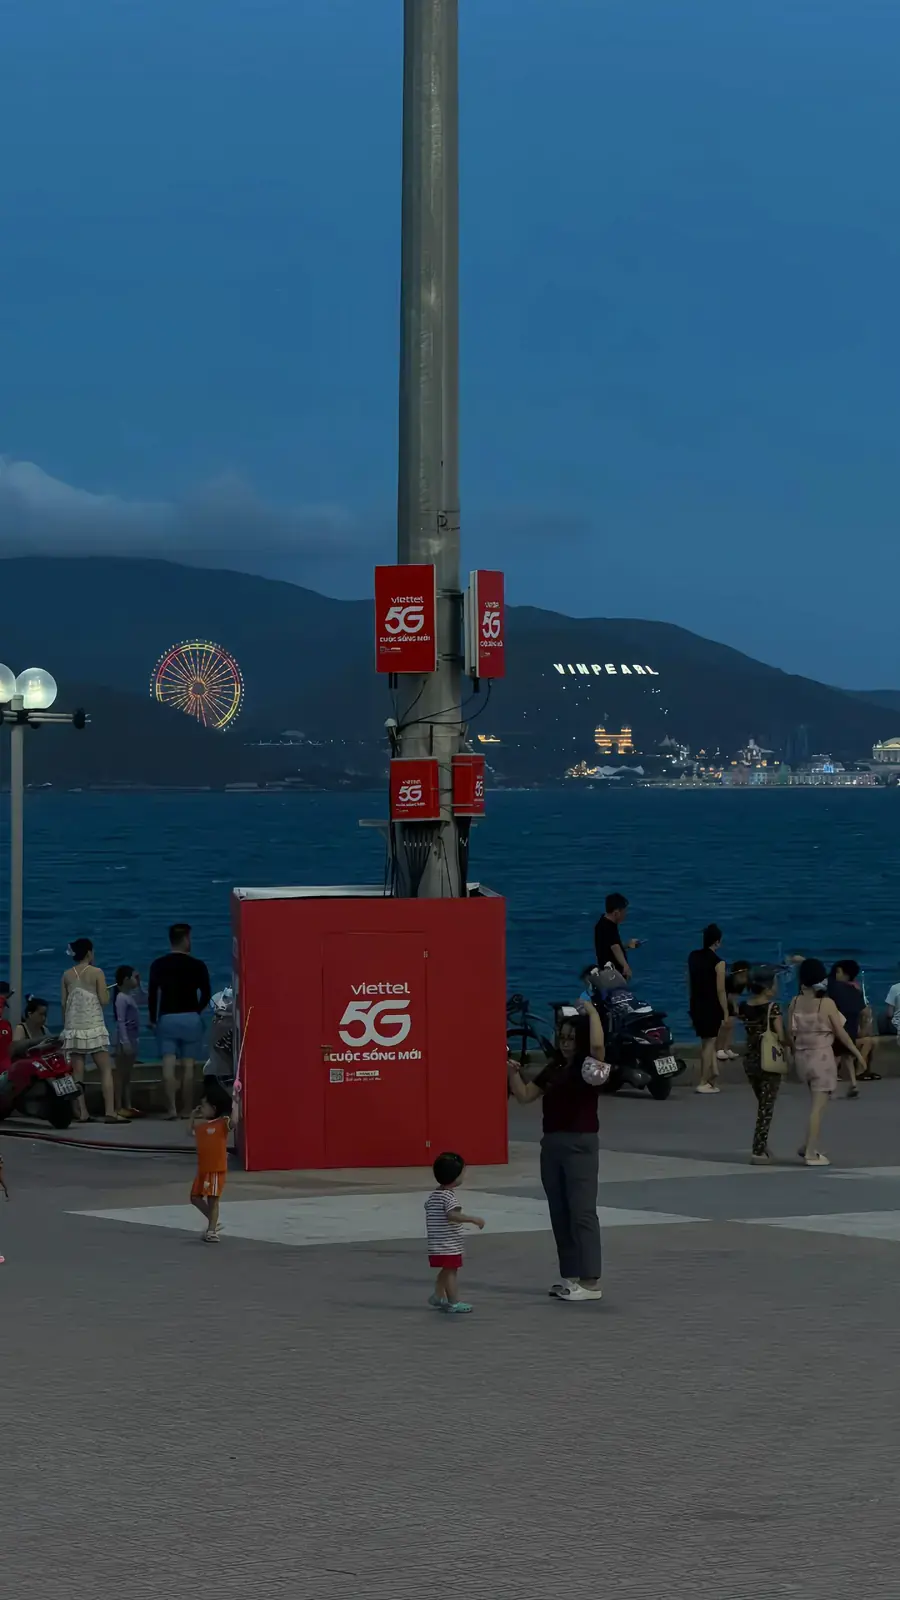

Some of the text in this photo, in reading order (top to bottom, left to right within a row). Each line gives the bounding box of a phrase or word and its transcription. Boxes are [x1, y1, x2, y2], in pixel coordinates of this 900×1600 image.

[391, 596, 424, 604] viettel
[384, 605, 425, 634] 5G
[482, 610, 501, 639] 5G
[553, 663, 660, 676] VINPEARL
[398, 784, 422, 802] 5G
[350, 982, 411, 996] viettel
[338, 999, 412, 1047] 5G
[329, 1047, 422, 1063] CUỘC SỐNG MỚI
